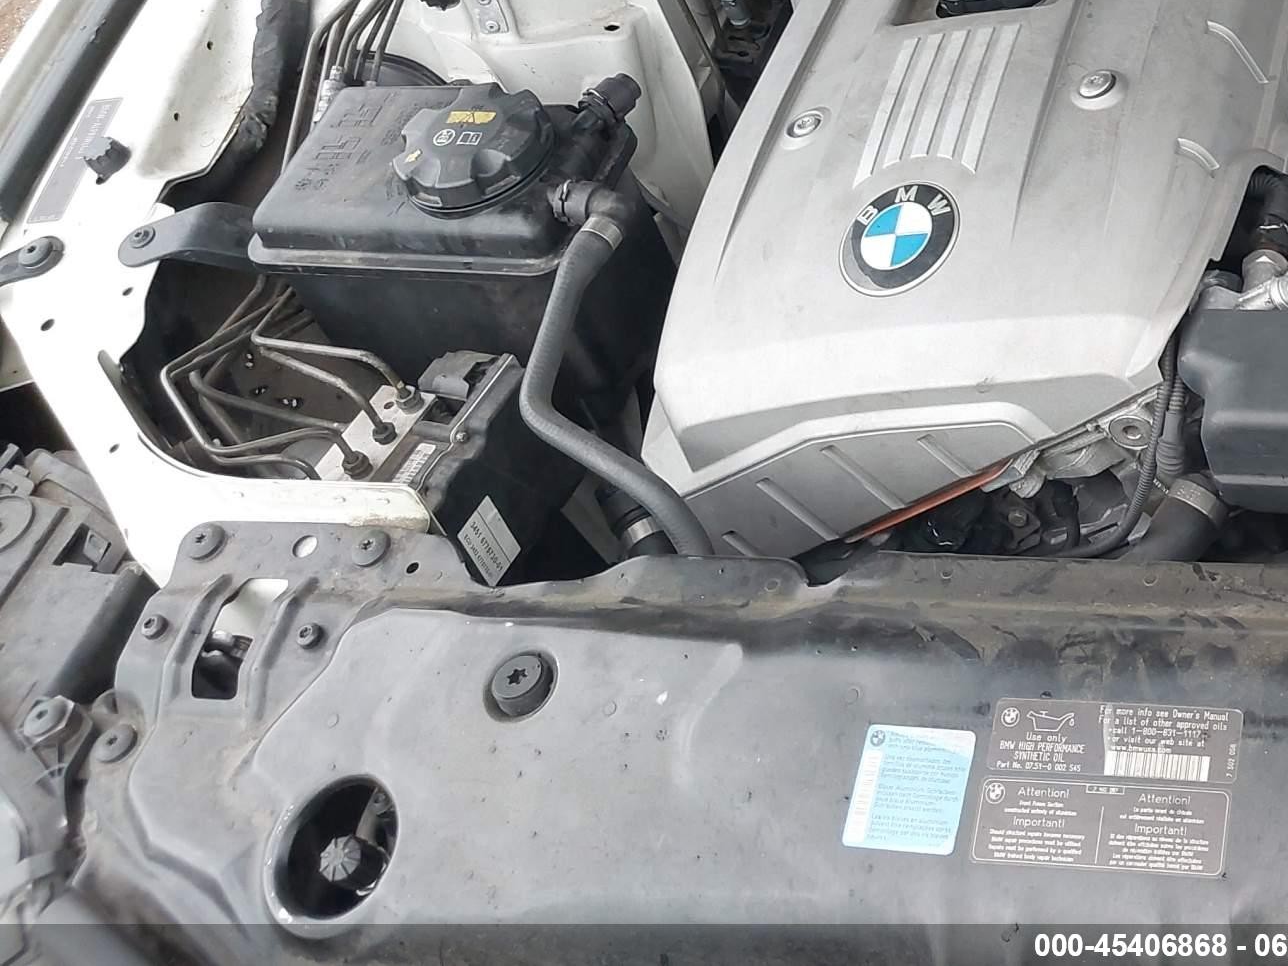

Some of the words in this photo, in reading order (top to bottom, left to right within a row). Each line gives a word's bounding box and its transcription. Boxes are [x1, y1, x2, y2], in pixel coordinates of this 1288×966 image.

[857, 185, 951, 226] BMW
[1100, 705, 1113, 714] For
[1116, 708, 1133, 716] more
[1138, 707, 1152, 717] info
[1156, 710, 1169, 718] see
[1172, 709, 1200, 719] Owner's
[1203, 710, 1229, 722] Manual
[1098, 714, 1111, 724] For
[1123, 717, 1137, 726] list
[1140, 717, 1149, 726] of
[1152, 718, 1172, 728] other
[1176, 721, 1209, 730] approved
[1212, 722, 1228, 731] oils
[1026, 732, 1042, 741] Use
[1046, 733, 1067, 743] only
[1123, 735, 1141, 744] visit
[1160, 737, 1175, 746] web
[1178, 739, 1193, 747] site
[1196, 739, 1205, 747] at
[999, 740, 1016, 750] BMW
[1018, 741, 1034, 751] HIGH
[1037, 742, 1086, 754] PERFORMANCE
[1014, 751, 1051, 762] SYNTHETIC
[1053, 753, 1065, 763] OIL
[996, 760, 1010, 768] Part
[1012, 761, 1022, 769] No.
[1017, 787, 1070, 799] Attention!
[1138, 793, 1191, 805] Attention!
[1013, 816, 1065, 828] Important!
[1134, 823, 1187, 836] Important!
